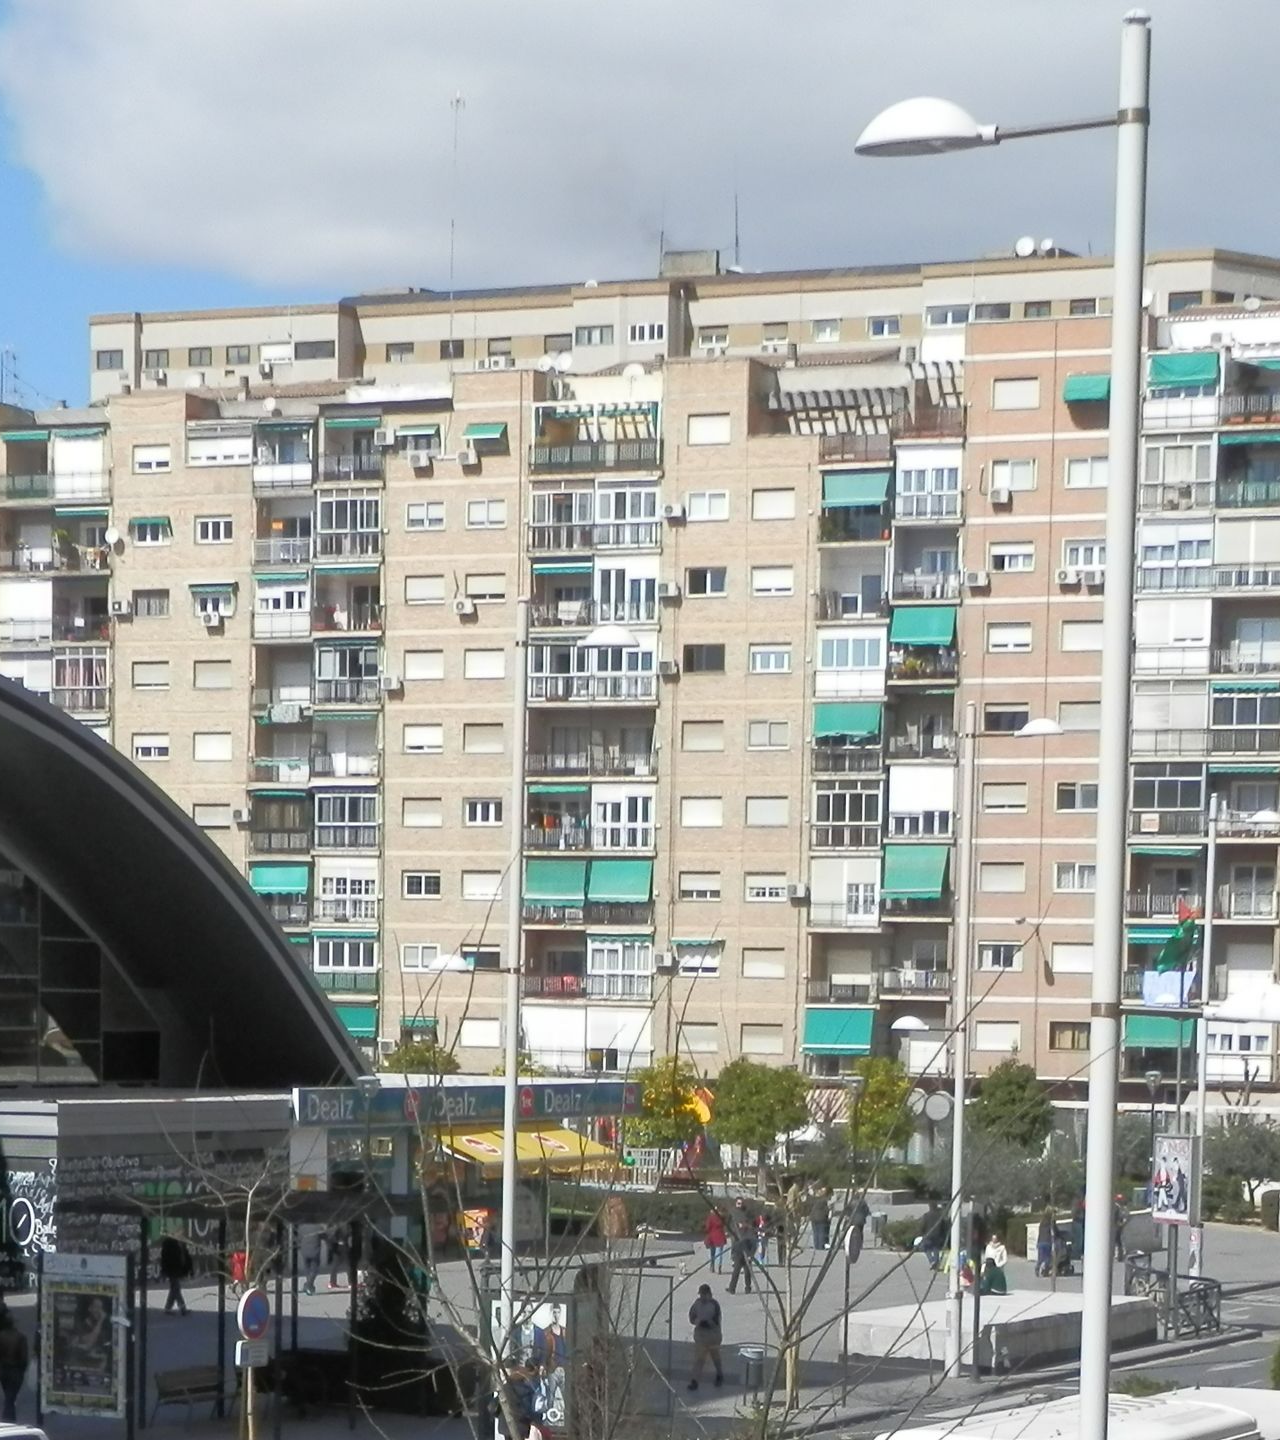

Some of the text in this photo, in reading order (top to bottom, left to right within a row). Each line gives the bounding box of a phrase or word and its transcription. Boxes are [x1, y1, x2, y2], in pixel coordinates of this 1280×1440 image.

[307, 1092, 353, 1121] Dealz
[434, 1090, 477, 1117] Dealz
[543, 1088, 582, 1113] Dealz
